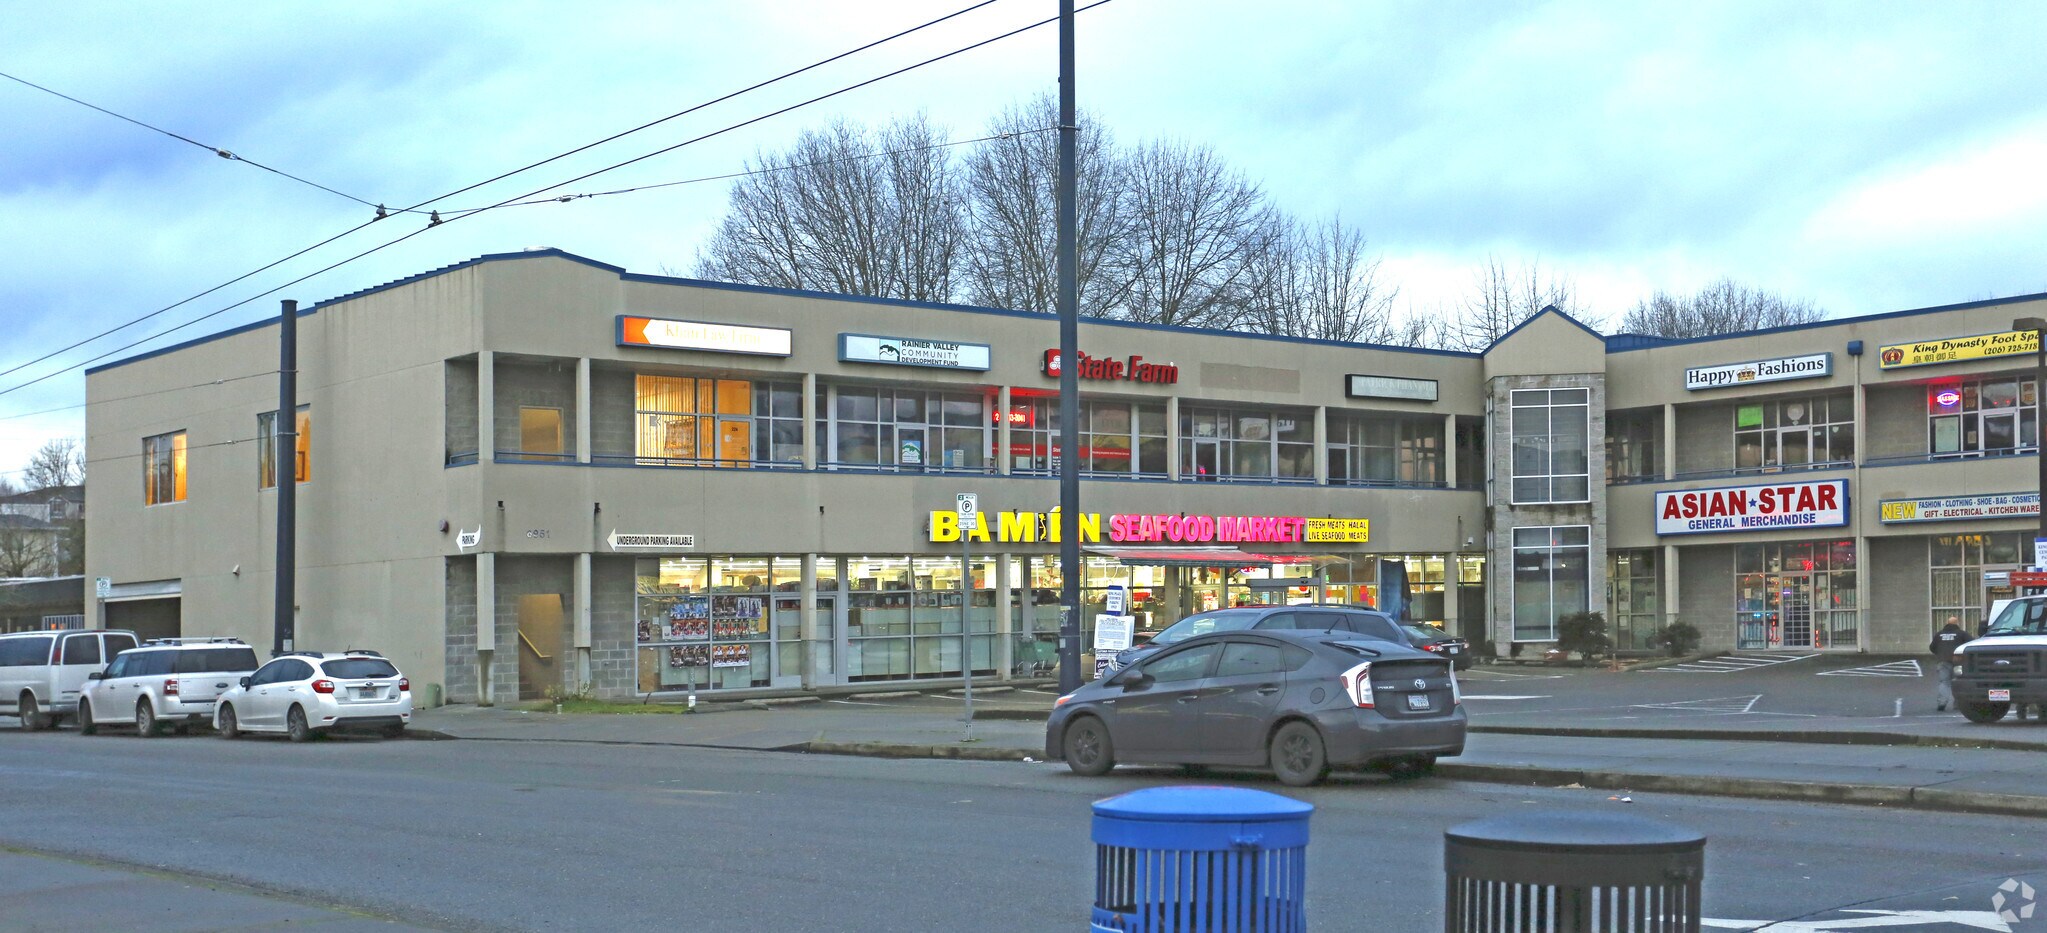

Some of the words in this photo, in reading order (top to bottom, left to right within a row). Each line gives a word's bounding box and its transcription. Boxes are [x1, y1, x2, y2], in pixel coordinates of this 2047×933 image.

[901, 340, 931, 350] RAINIER
[933, 342, 959, 351] VALLEY
[1913, 343, 1938, 354] King
[1941, 337, 1988, 350] Dynasty
[1991, 333, 2017, 345] Foot
[901, 348, 958, 359] COMMUNITY
[1984, 346, 2006, 355] (206)
[901, 356, 942, 366] DEVELOPMENT
[943, 359, 959, 367] FUND
[1128, 355, 1178, 385] Farm
[1688, 368, 1735, 386] Happy
[1757, 359, 1824, 376] Fashions
[1663, 490, 1747, 520] ASIAN
[1758, 484, 1838, 514] STAR
[1919, 500, 1942, 509] FASHION
[1945, 499, 1973, 508] CLOTHING
[1977, 497, 1993, 506] SHOE
[1996, 496, 2008, 505] BAG
[1881, 501, 1917, 520] NEW
[1924, 510, 1938, 518] GIFT
[1943, 508, 1983, 517] ELECTRICAL
[1989, 505, 2019, 515] KITCHEN
[2020, 504, 2040, 513] WARE
[1308, 520, 1326, 530] FRESH
[1327, 520, 1346, 530] MEATS
[1348, 521, 1367, 529] HALAL
[1688, 518, 1736, 530] GENERAL
[1741, 513, 1816, 528] MERCHANDISE
[1109, 514, 1215, 543] SEAFOOD
[1217, 516, 1304, 543] MARKET
[616, 535, 649, 546] UNDERGROUND
[650, 536, 669, 546] PARKING
[670, 536, 693, 546] AVAILABLE
[1308, 531, 1320, 540] LIVE
[1321, 531, 1346, 540] SEAFOOD
[1348, 532, 1367, 540] MEATS
